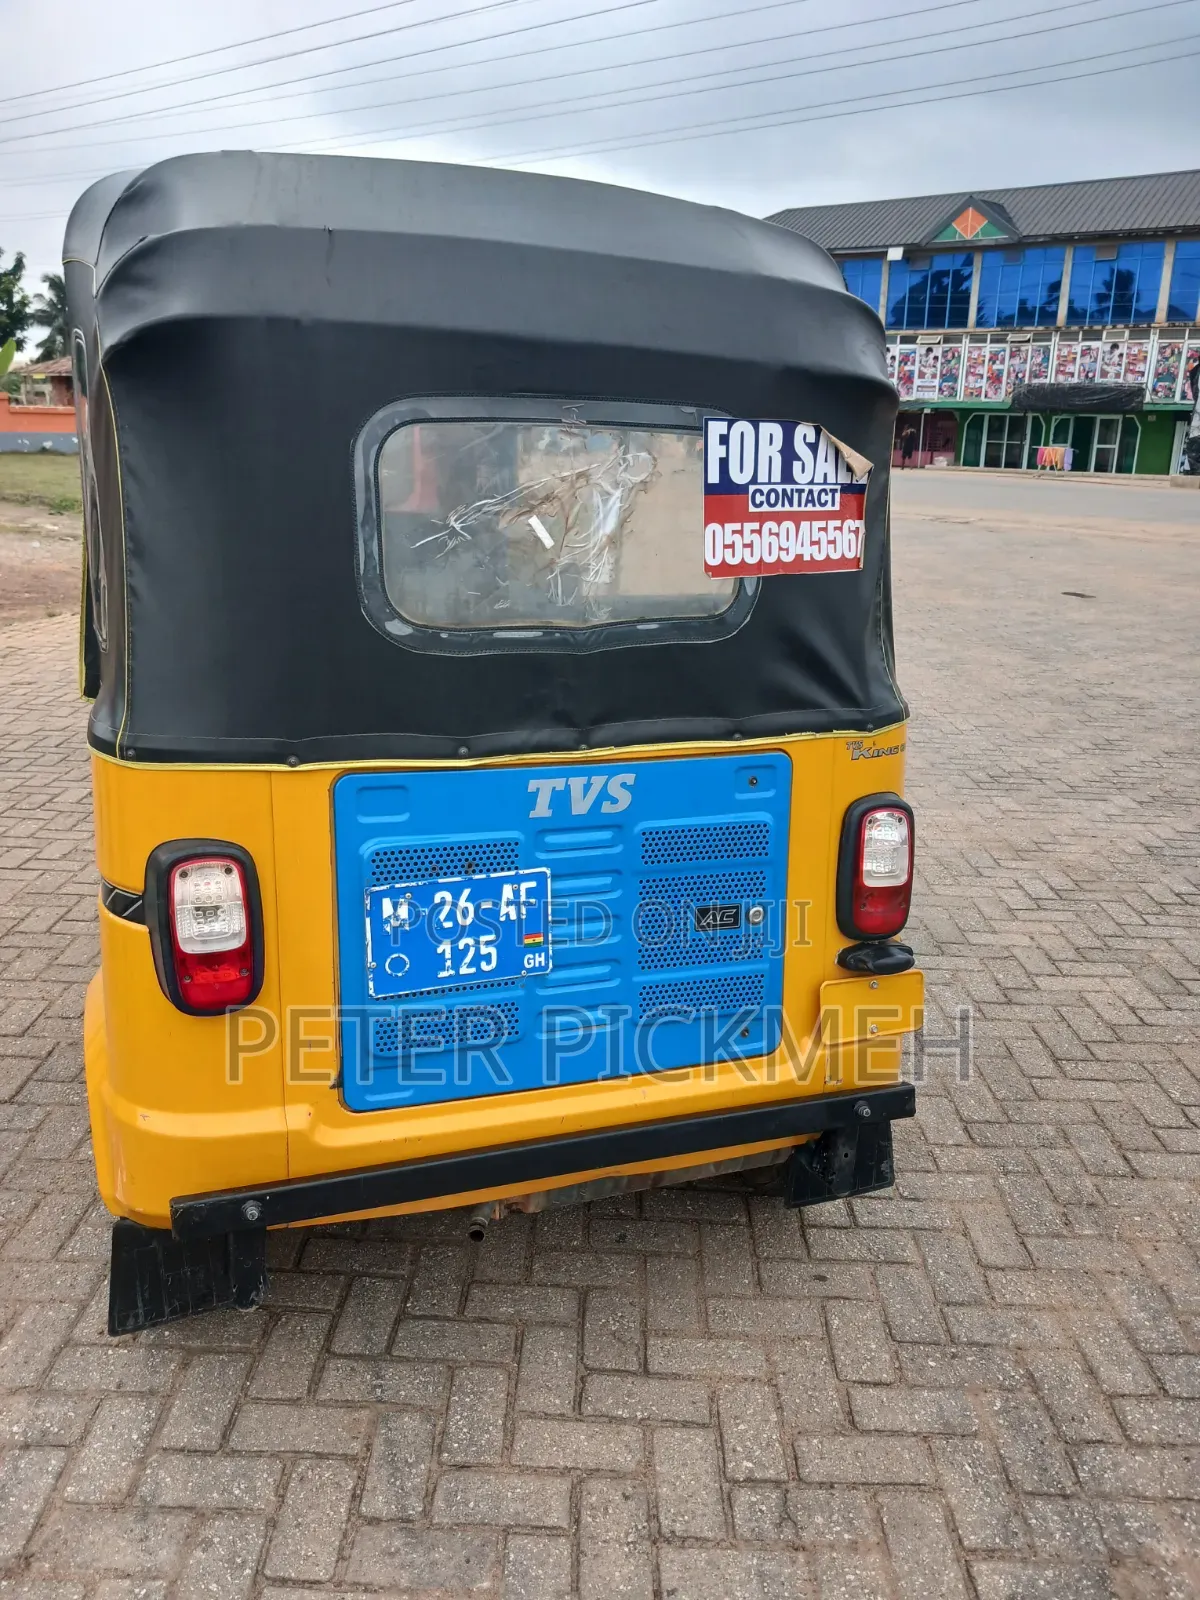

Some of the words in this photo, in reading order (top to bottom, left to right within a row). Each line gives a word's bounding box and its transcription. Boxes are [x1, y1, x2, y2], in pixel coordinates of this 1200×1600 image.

[707, 420, 784, 485] FOR
[793, 424, 868, 485] SAL
[750, 487, 838, 509] CONTACT
[704, 520, 864, 566] 0556945567
[527, 773, 637, 818] TVS
[436, 934, 498, 978] 125
[523, 952, 546, 969] GH
